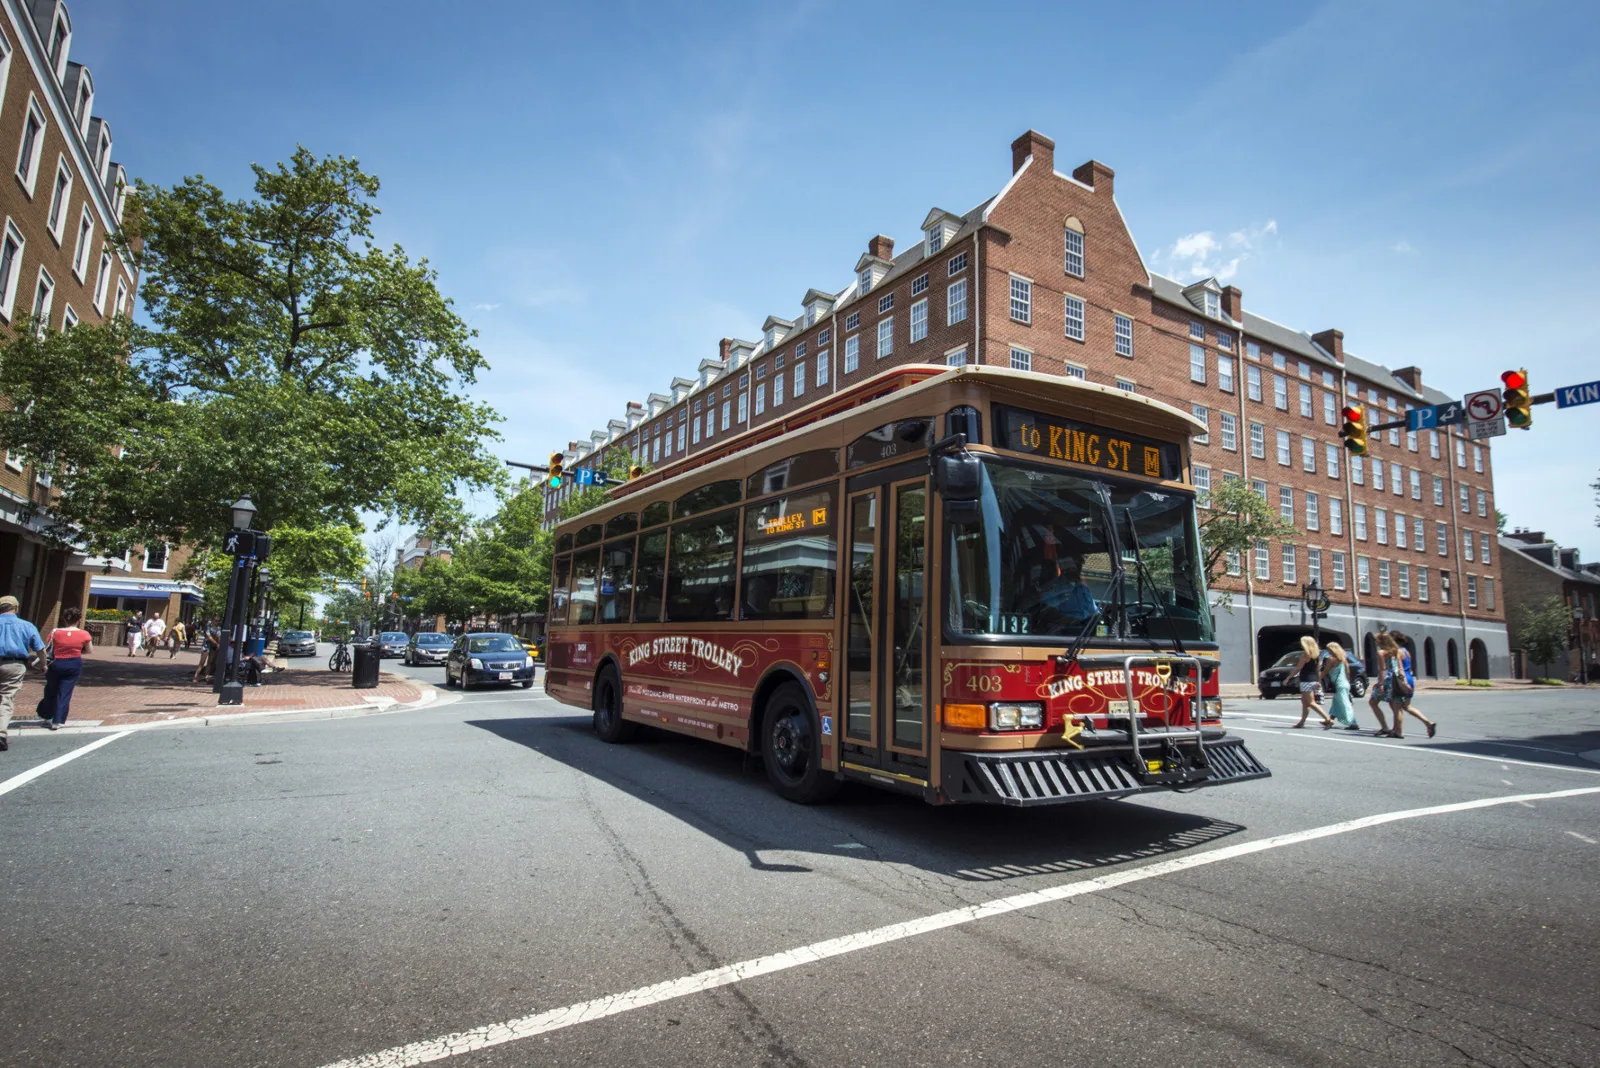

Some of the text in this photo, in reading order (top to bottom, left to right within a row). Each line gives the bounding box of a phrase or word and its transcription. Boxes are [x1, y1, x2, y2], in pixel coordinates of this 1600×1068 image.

[1416, 409, 1433, 430] P
[880, 443, 897, 458] 403
[1021, 423, 1041, 448] to
[1048, 425, 1100, 465] KING
[1107, 438, 1131, 471] ST
[579, 470, 591, 483] P
[765, 520, 806, 535] TO KING ST
[768, 513, 803, 528] TROLLEY
[629, 636, 742, 677] KING STREET TROLLEY
[668, 661, 687, 672] FREE
[966, 675, 1003, 692] 403
[1048, 674, 1083, 699] KING
[662, 692, 675, 700] RIVER
[675, 694, 706, 706] WATERFRONT
[718, 701, 739, 711] METRO
